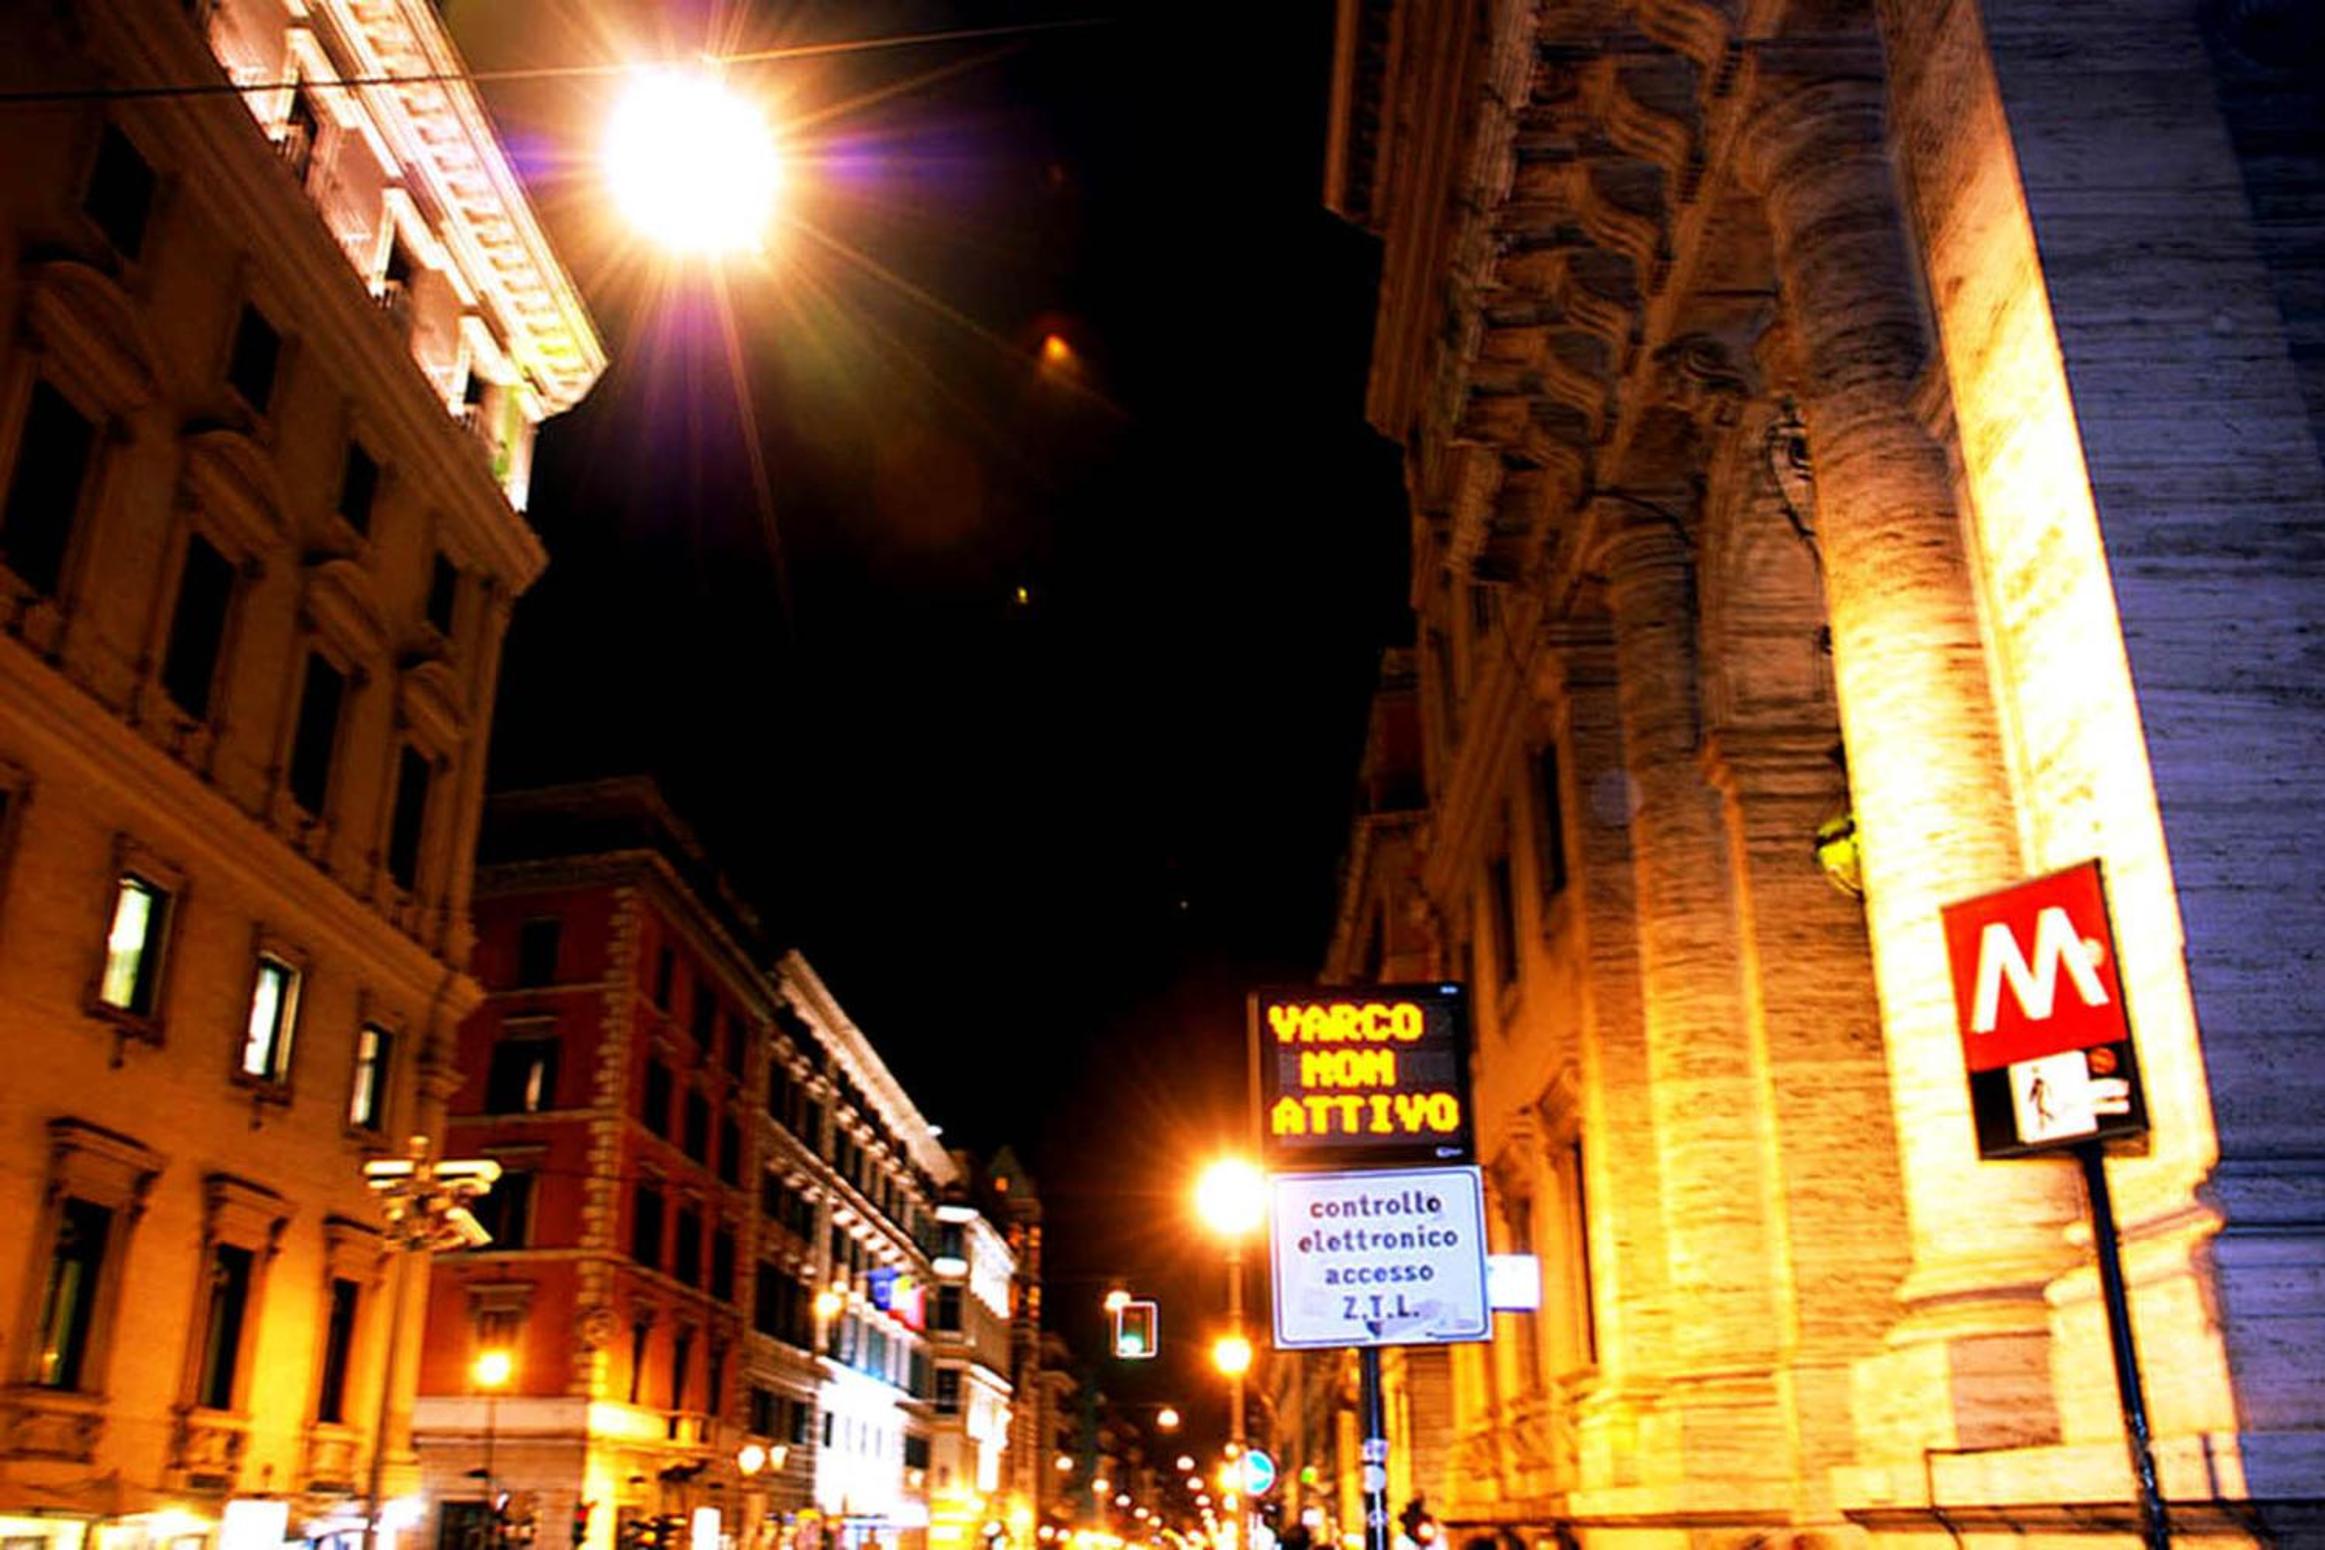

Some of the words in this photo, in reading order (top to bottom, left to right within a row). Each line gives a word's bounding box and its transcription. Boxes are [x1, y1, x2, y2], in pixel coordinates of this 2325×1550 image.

[1268, 1003, 1424, 1042] VARCO
[1272, 1093, 1460, 1135] ATTIVO
[1310, 1191, 1442, 1219] controllo
[1298, 1225, 1458, 1253] elettronico
[1325, 1265, 1434, 1285] accesso
[1343, 1294, 1420, 1320] Z.T.L.
